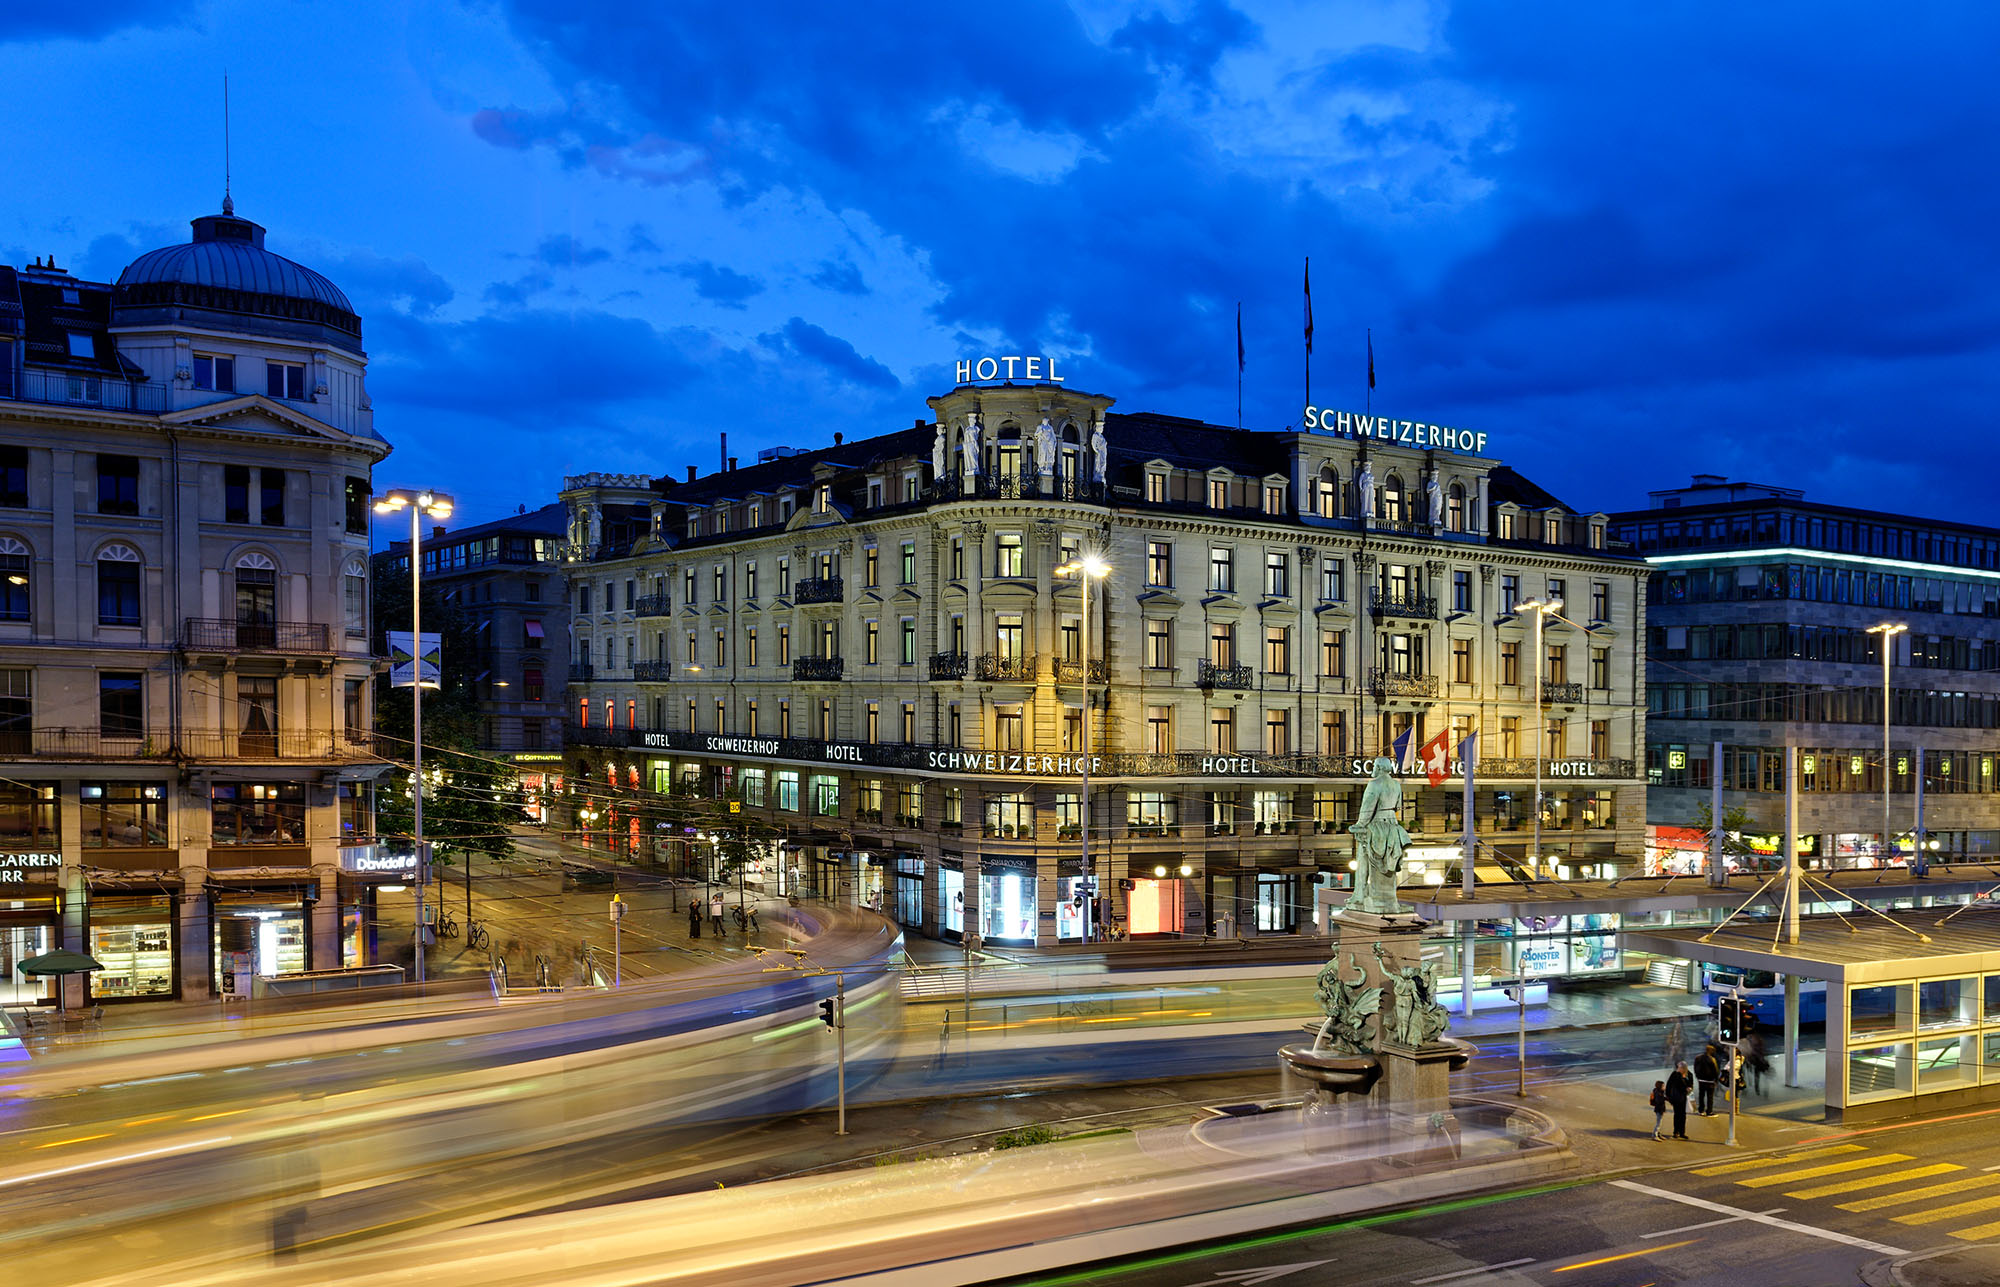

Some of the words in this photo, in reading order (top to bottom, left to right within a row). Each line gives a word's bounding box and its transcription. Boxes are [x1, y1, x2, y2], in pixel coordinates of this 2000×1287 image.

[956, 356, 1065, 383] HOTEL
[1305, 406, 1487, 452] SCHWEIZERHOF
[645, 733, 670, 747] HOTEL
[707, 736, 779, 755] SCHWEIZERHOF
[826, 745, 863, 761] HOTEL
[929, 751, 1101, 775] SCHWEIZERHOF
[1202, 757, 1260, 773] HOTEL
[1550, 762, 1595, 776] HOTEL
[357, 856, 405, 870] Davidoff
